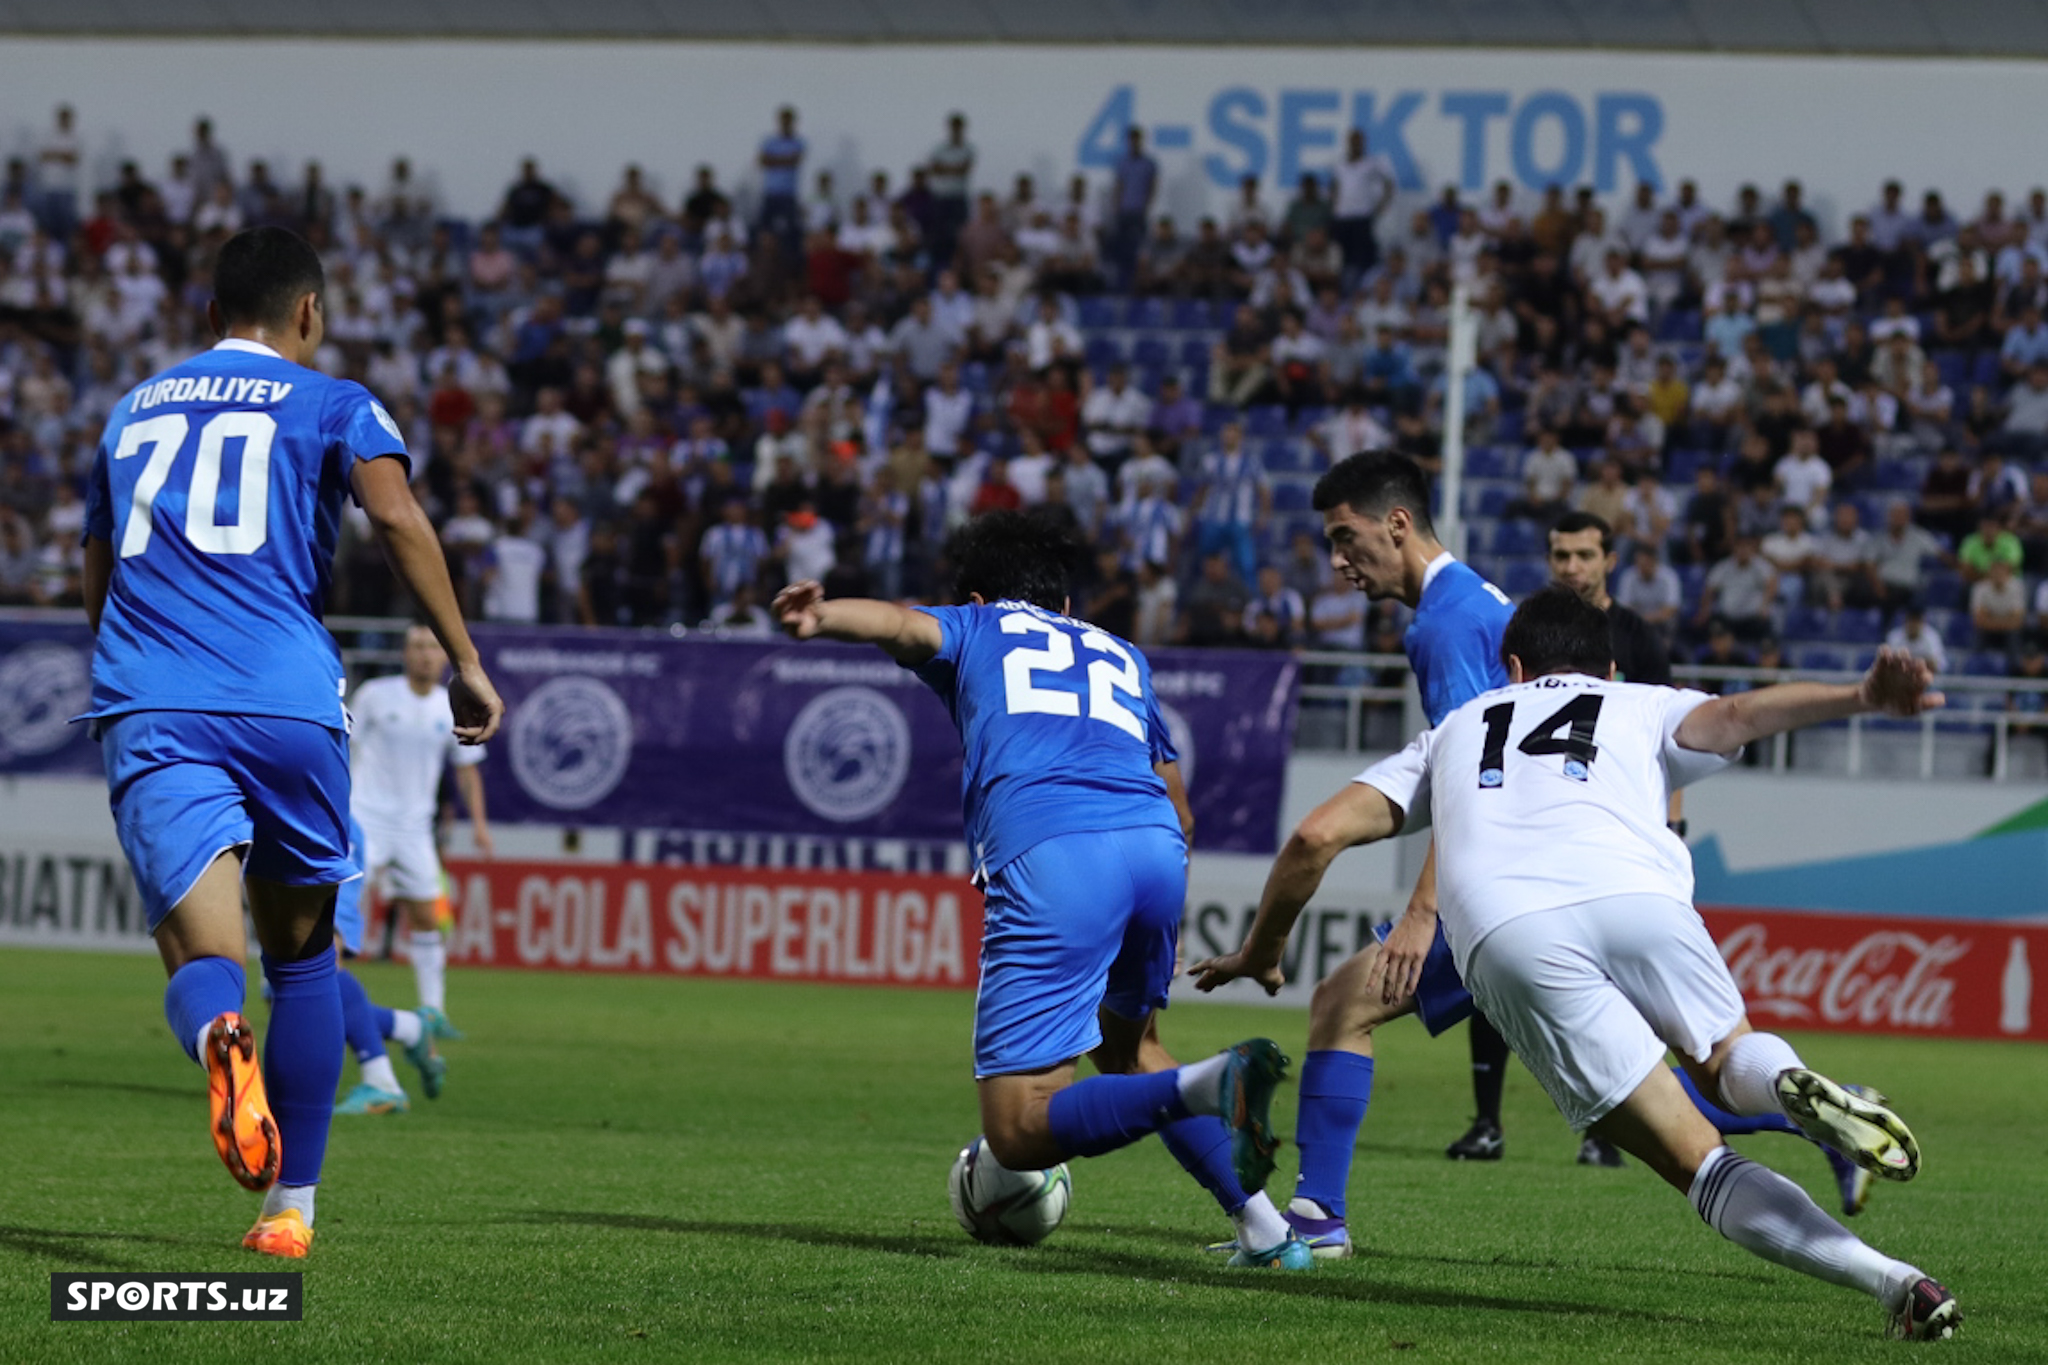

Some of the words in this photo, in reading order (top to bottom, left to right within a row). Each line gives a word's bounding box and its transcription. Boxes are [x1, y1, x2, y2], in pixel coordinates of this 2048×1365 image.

[1077, 85, 1666, 194] 4-SEKTOR
[130, 376, 293, 413] TURDALIYEV
[114, 411, 277, 558] 70
[1000, 611, 1148, 742] 22
[1479, 693, 1605, 789] 14
[666, 880, 965, 983] SUPERLIGA
